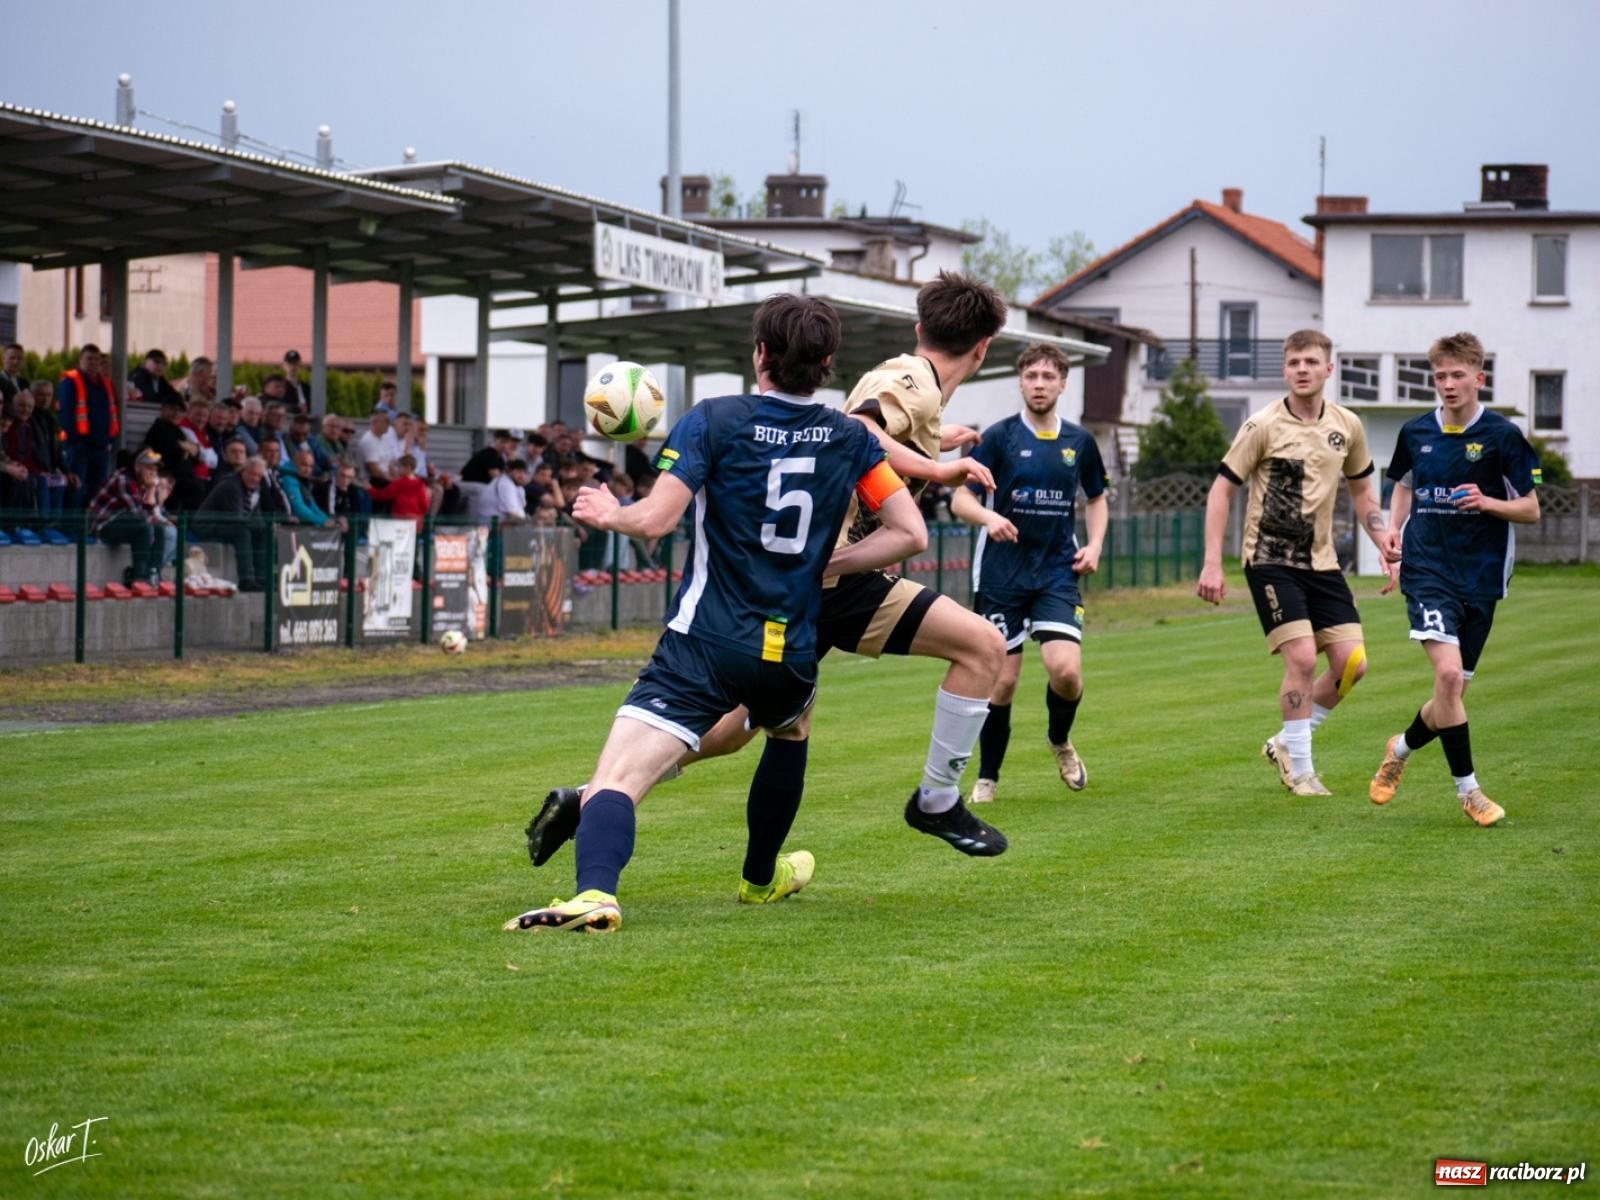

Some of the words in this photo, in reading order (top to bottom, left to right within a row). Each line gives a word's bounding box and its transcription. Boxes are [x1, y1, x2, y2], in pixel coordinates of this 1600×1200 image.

[617, 241, 641, 279] LKS
[754, 425, 788, 446] BUK
[760, 457, 816, 554] 5
[1035, 489, 1063, 500] OLTO
